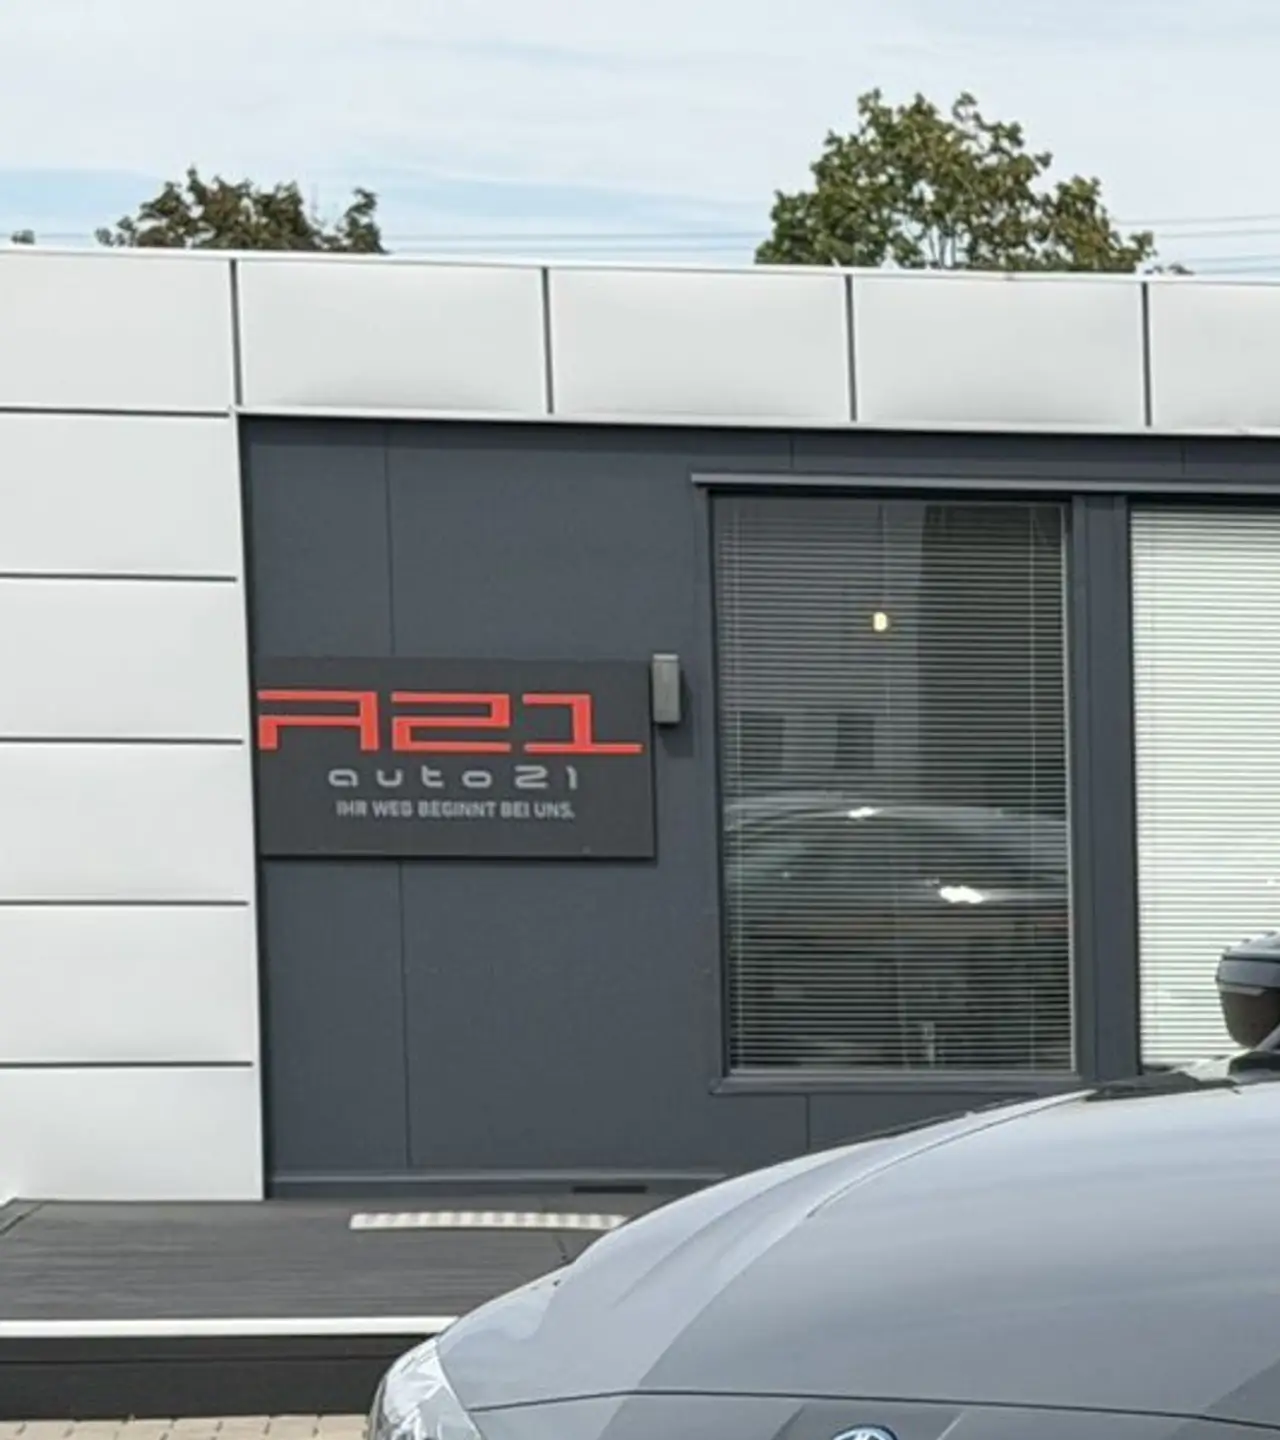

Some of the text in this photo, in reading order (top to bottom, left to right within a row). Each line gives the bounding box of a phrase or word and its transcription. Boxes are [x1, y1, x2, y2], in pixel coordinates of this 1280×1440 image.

[256, 689, 644, 754] A21
[335, 801, 368, 817] IHR
[372, 801, 413, 817] WEG
[417, 801, 496, 818] BEGINNT
[500, 801, 530, 818] BEI
